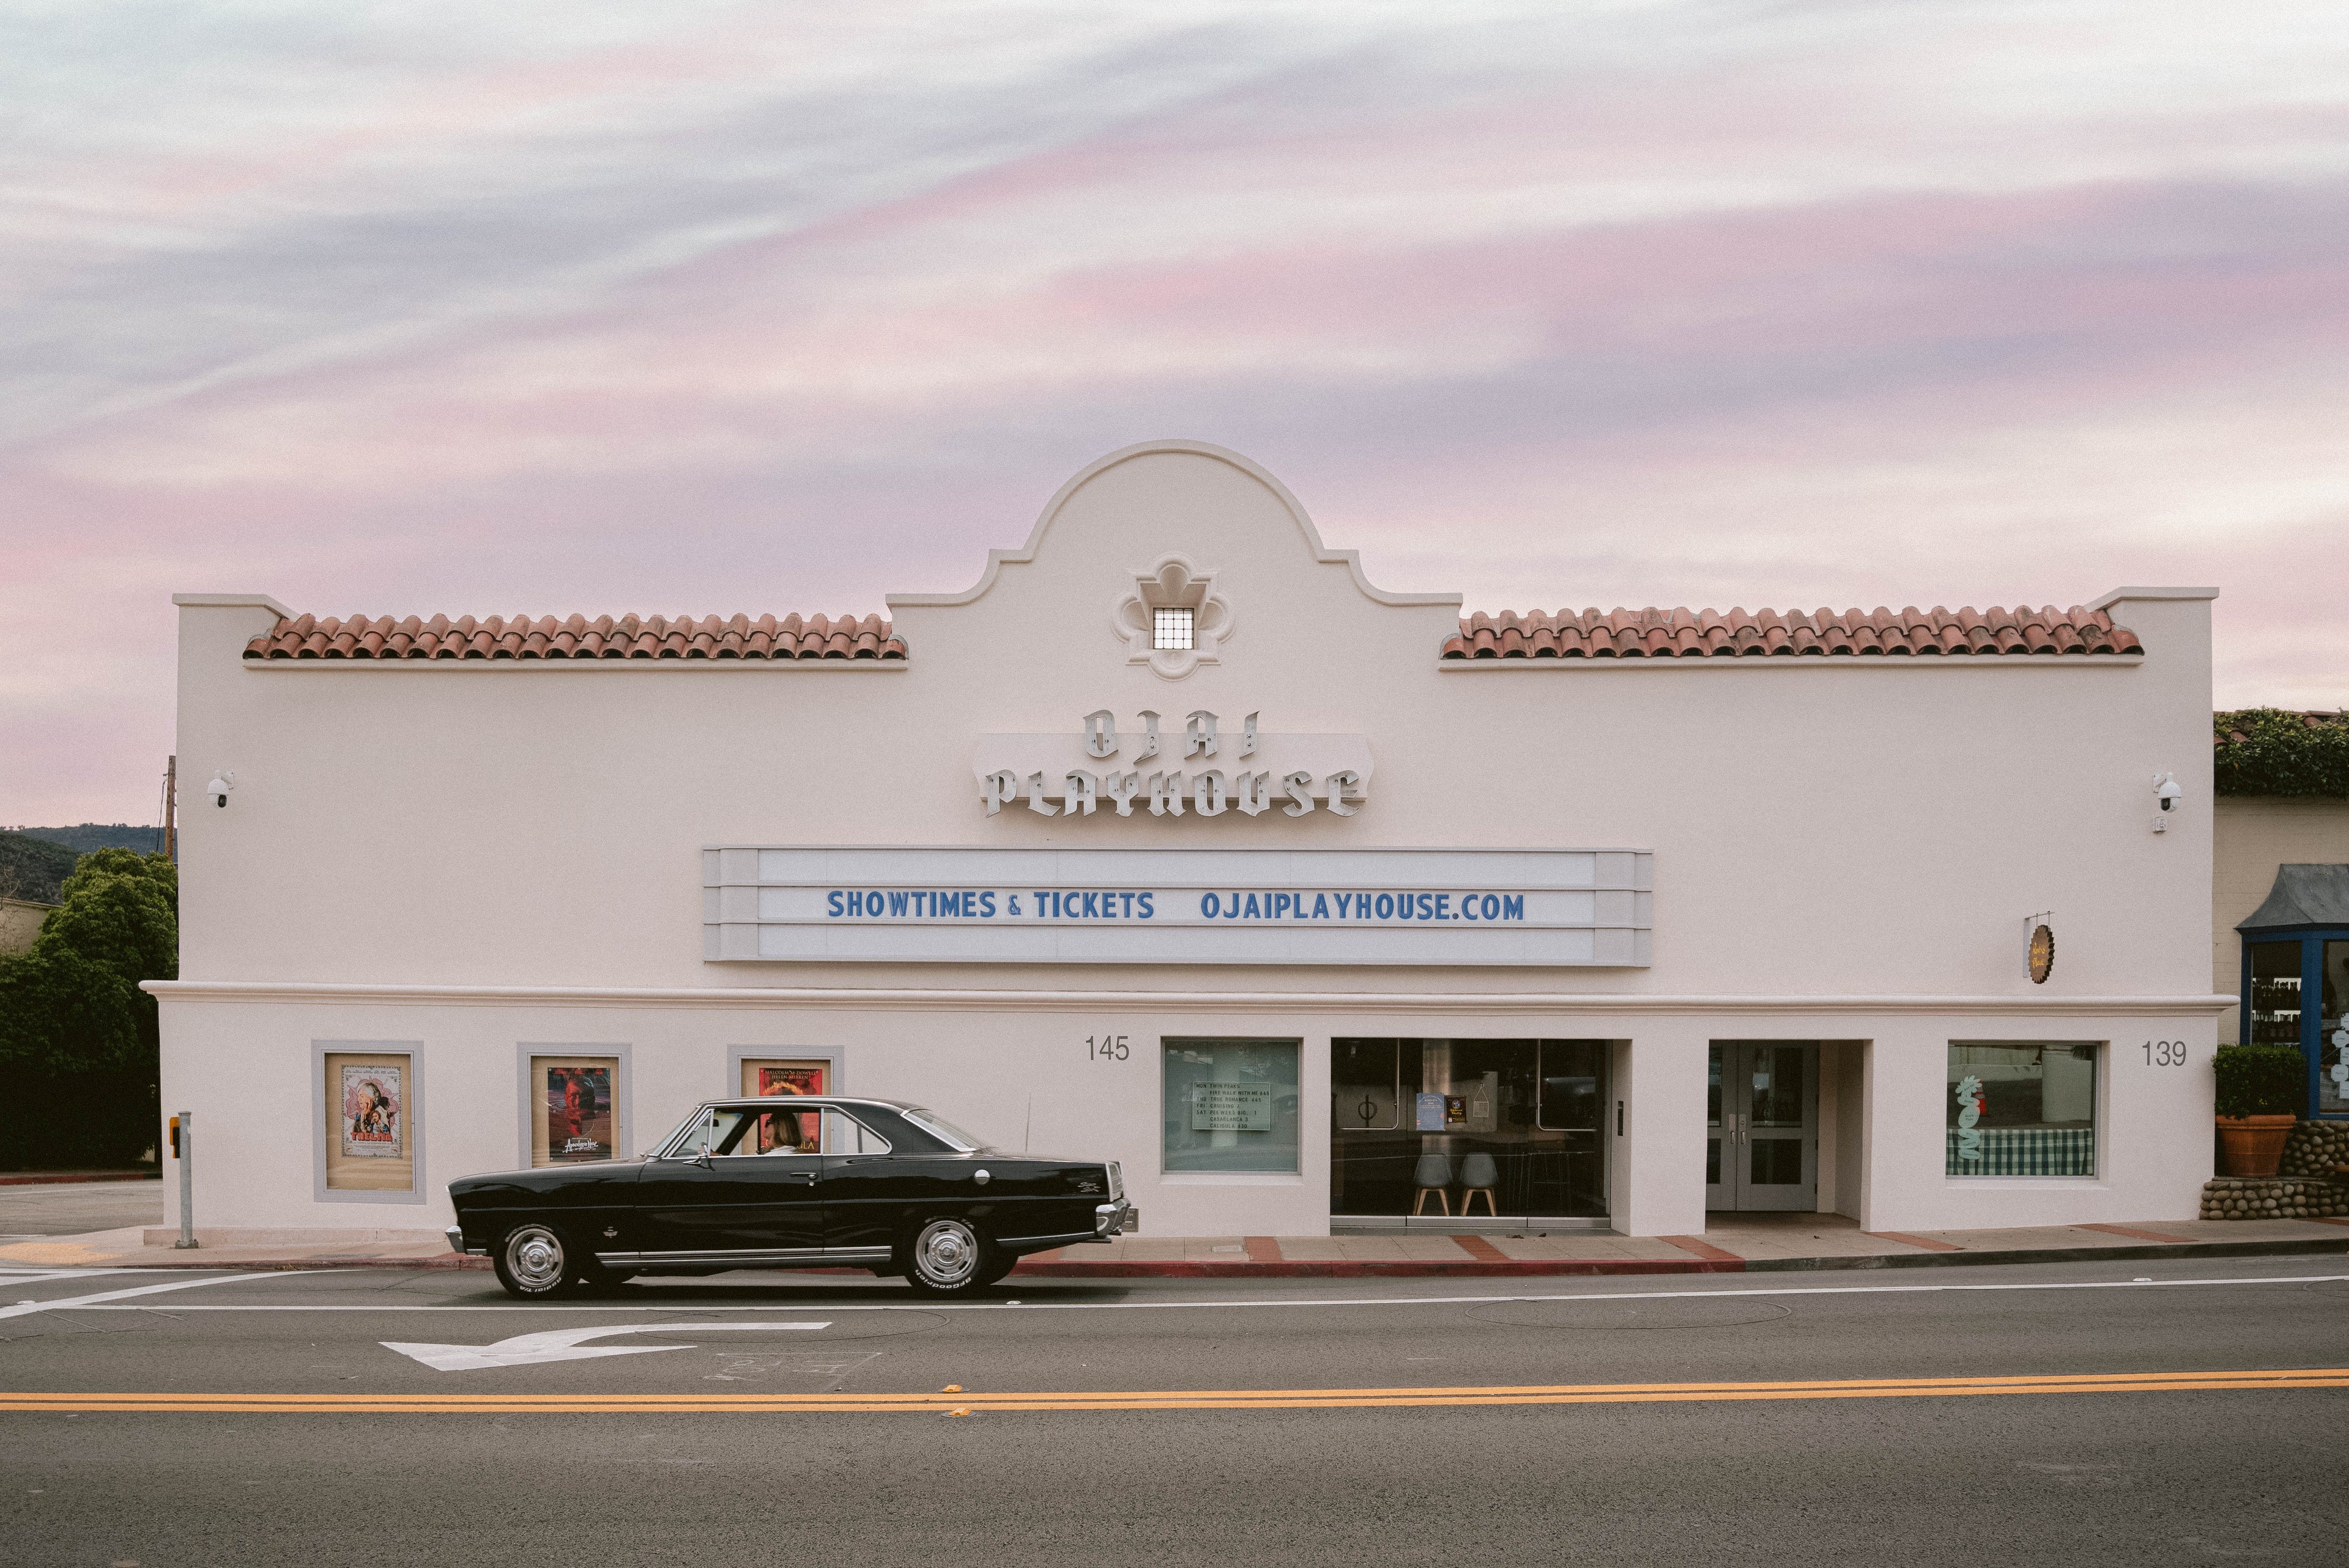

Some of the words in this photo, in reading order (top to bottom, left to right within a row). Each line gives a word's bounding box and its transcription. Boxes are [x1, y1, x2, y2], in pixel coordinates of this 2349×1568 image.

[1083, 709, 1260, 764] OJAI
[985, 769, 1362, 818] PLAYHOUSE
[828, 890, 995, 918] SHOWTIMES
[1008, 895, 1021, 915] &
[1033, 892, 1154, 919] TICKETS
[1200, 893, 1524, 921] OJAIPLAYHOUSE.COM
[1085, 1035, 1130, 1061] 145
[2142, 1040, 2187, 1067] 139
[351, 1132, 393, 1142] THELMA
[562, 1138, 588, 1153] Apocalypse
[915, 1269, 971, 1289] BFGoodrich
